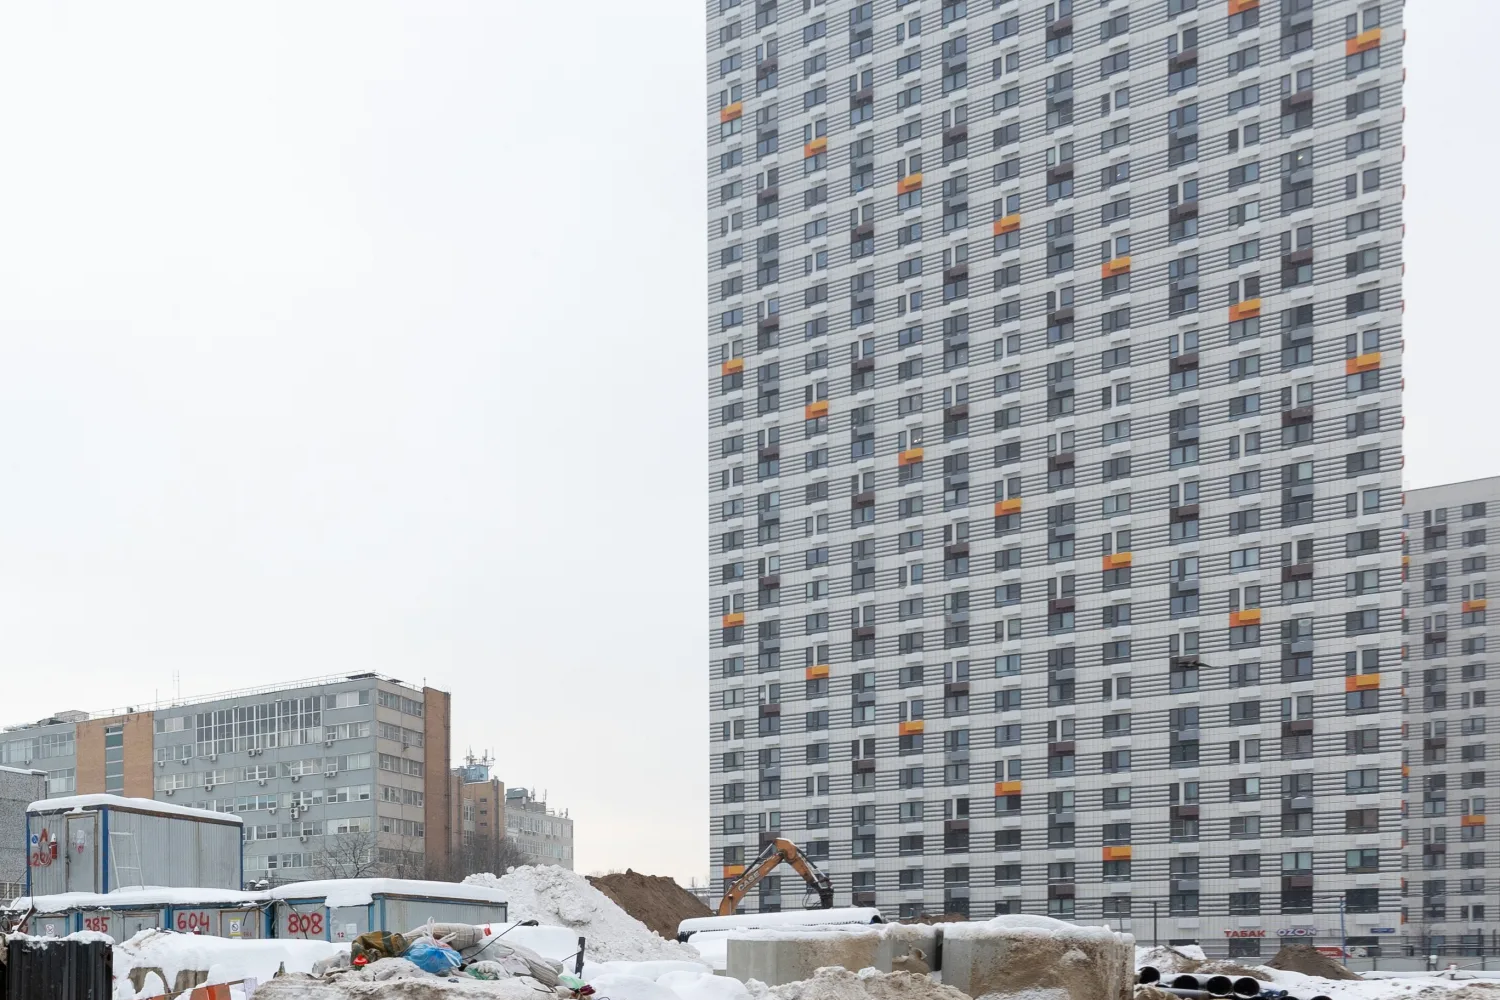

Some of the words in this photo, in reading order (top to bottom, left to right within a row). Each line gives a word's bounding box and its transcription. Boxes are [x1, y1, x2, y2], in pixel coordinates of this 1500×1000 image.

[738, 870, 760, 891] CASE
[84, 916, 111, 933] 385
[177, 911, 210, 932] 604
[287, 912, 323, 935] 808
[1224, 929, 1266, 938] ТАБАК
[1277, 928, 1317, 937] OZON
